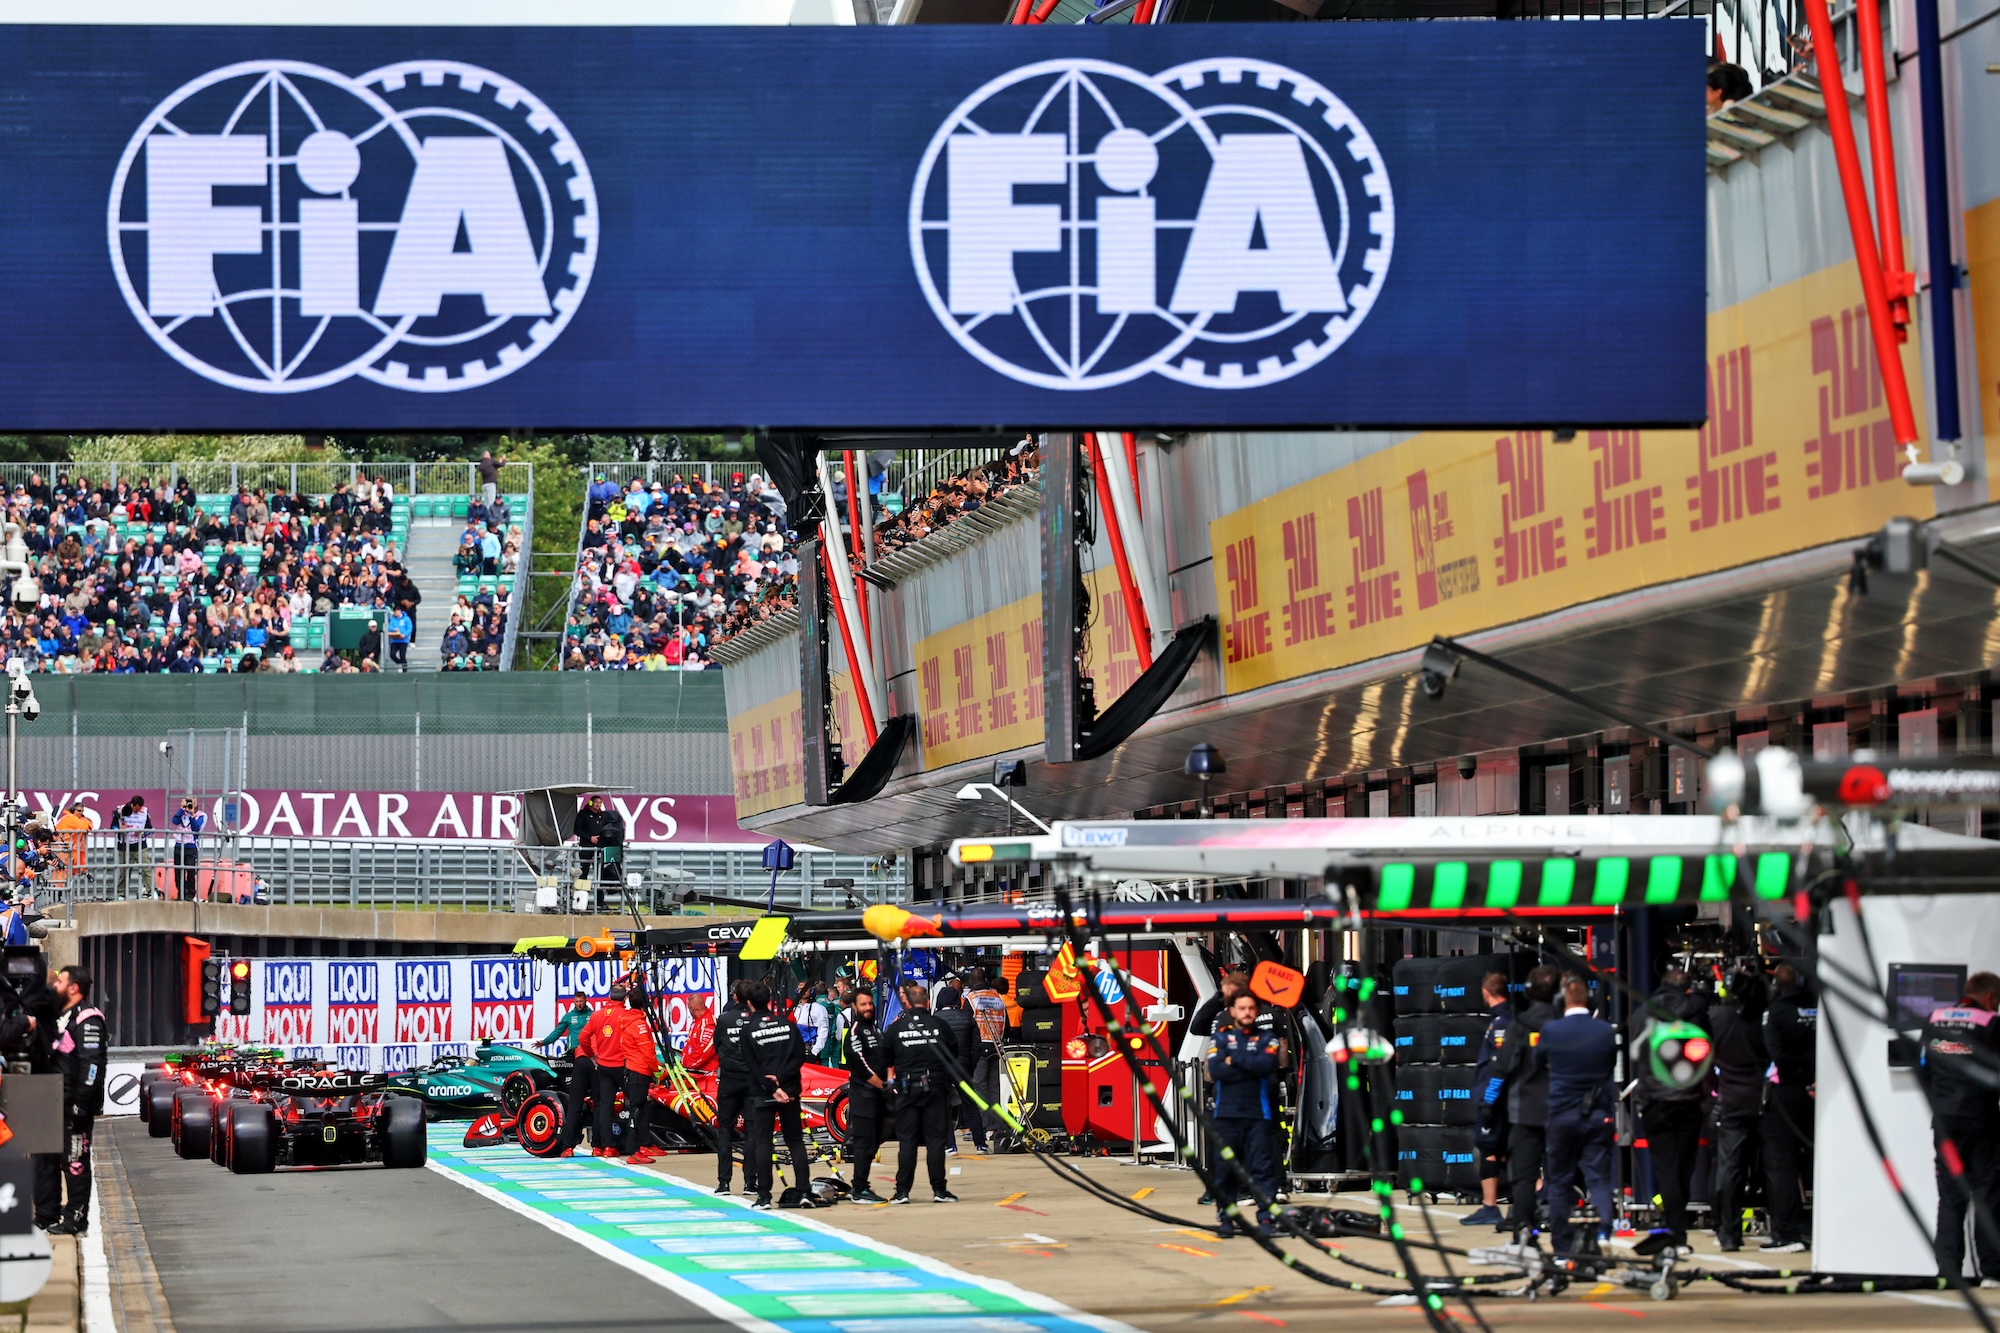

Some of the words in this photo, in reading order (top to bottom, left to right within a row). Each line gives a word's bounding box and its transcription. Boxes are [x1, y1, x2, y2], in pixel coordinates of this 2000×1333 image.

[213, 791, 412, 838] QATAR
[428, 794, 678, 841] AIRYS
[1430, 824, 1587, 838] ALPINE
[265, 965, 312, 1004] LIQUI
[330, 965, 377, 1002] LIQUI
[397, 964, 450, 1003] LIQUI
[473, 962, 532, 1001] LIQUI
[1268, 966, 1294, 981] BRAKES
[265, 1008, 312, 1044] MOLY
[330, 1007, 377, 1043] MOLY
[397, 1006, 450, 1042] MOLY
[474, 1005, 533, 1040] MOLY
[751, 1025, 790, 1039] PETRONAS
[338, 1048, 370, 1072] LIQUI
[281, 1074, 375, 1090] ORACLE
[428, 1085, 472, 1097] aramco
